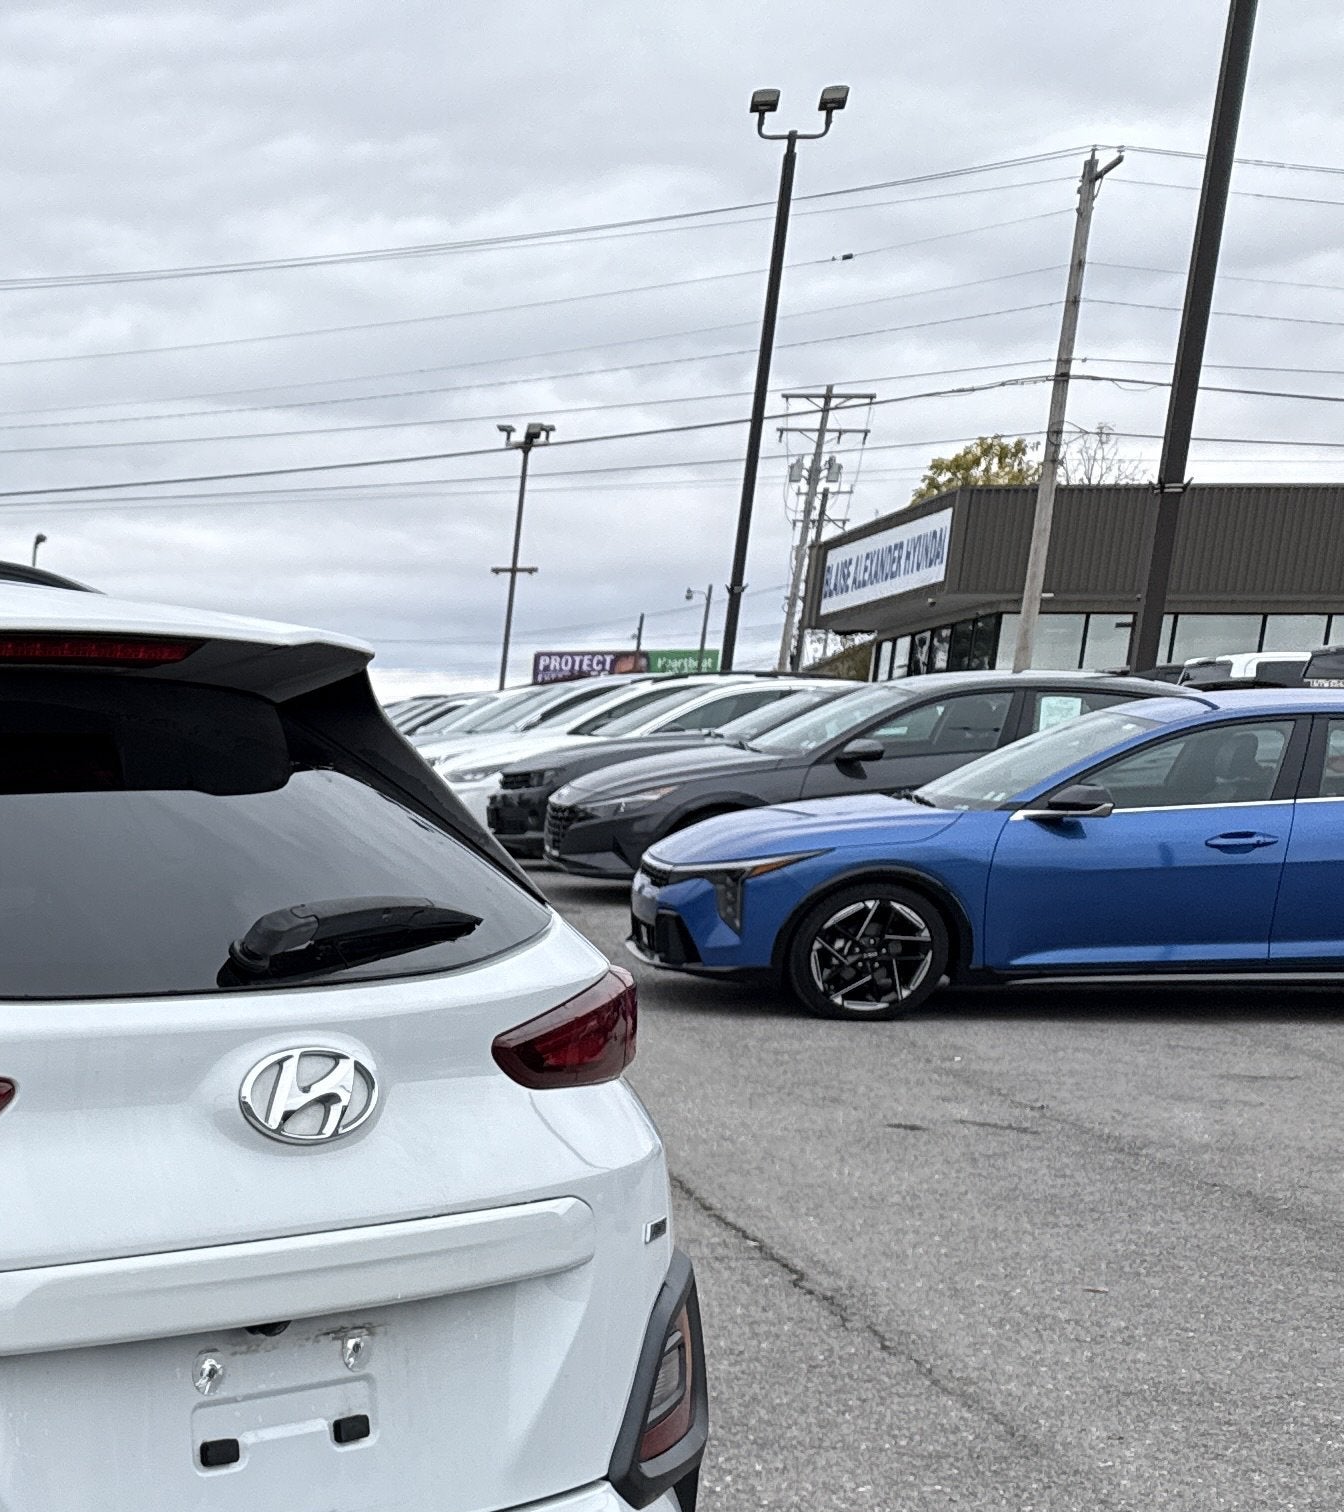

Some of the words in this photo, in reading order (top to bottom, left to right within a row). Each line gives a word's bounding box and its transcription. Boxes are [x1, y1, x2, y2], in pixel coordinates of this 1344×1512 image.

[823, 558, 853, 599] BLAISE
[851, 541, 905, 592] ALEXANDER
[903, 526, 947, 577] HYUNDAI
[538, 655, 614, 671] PROTECT
